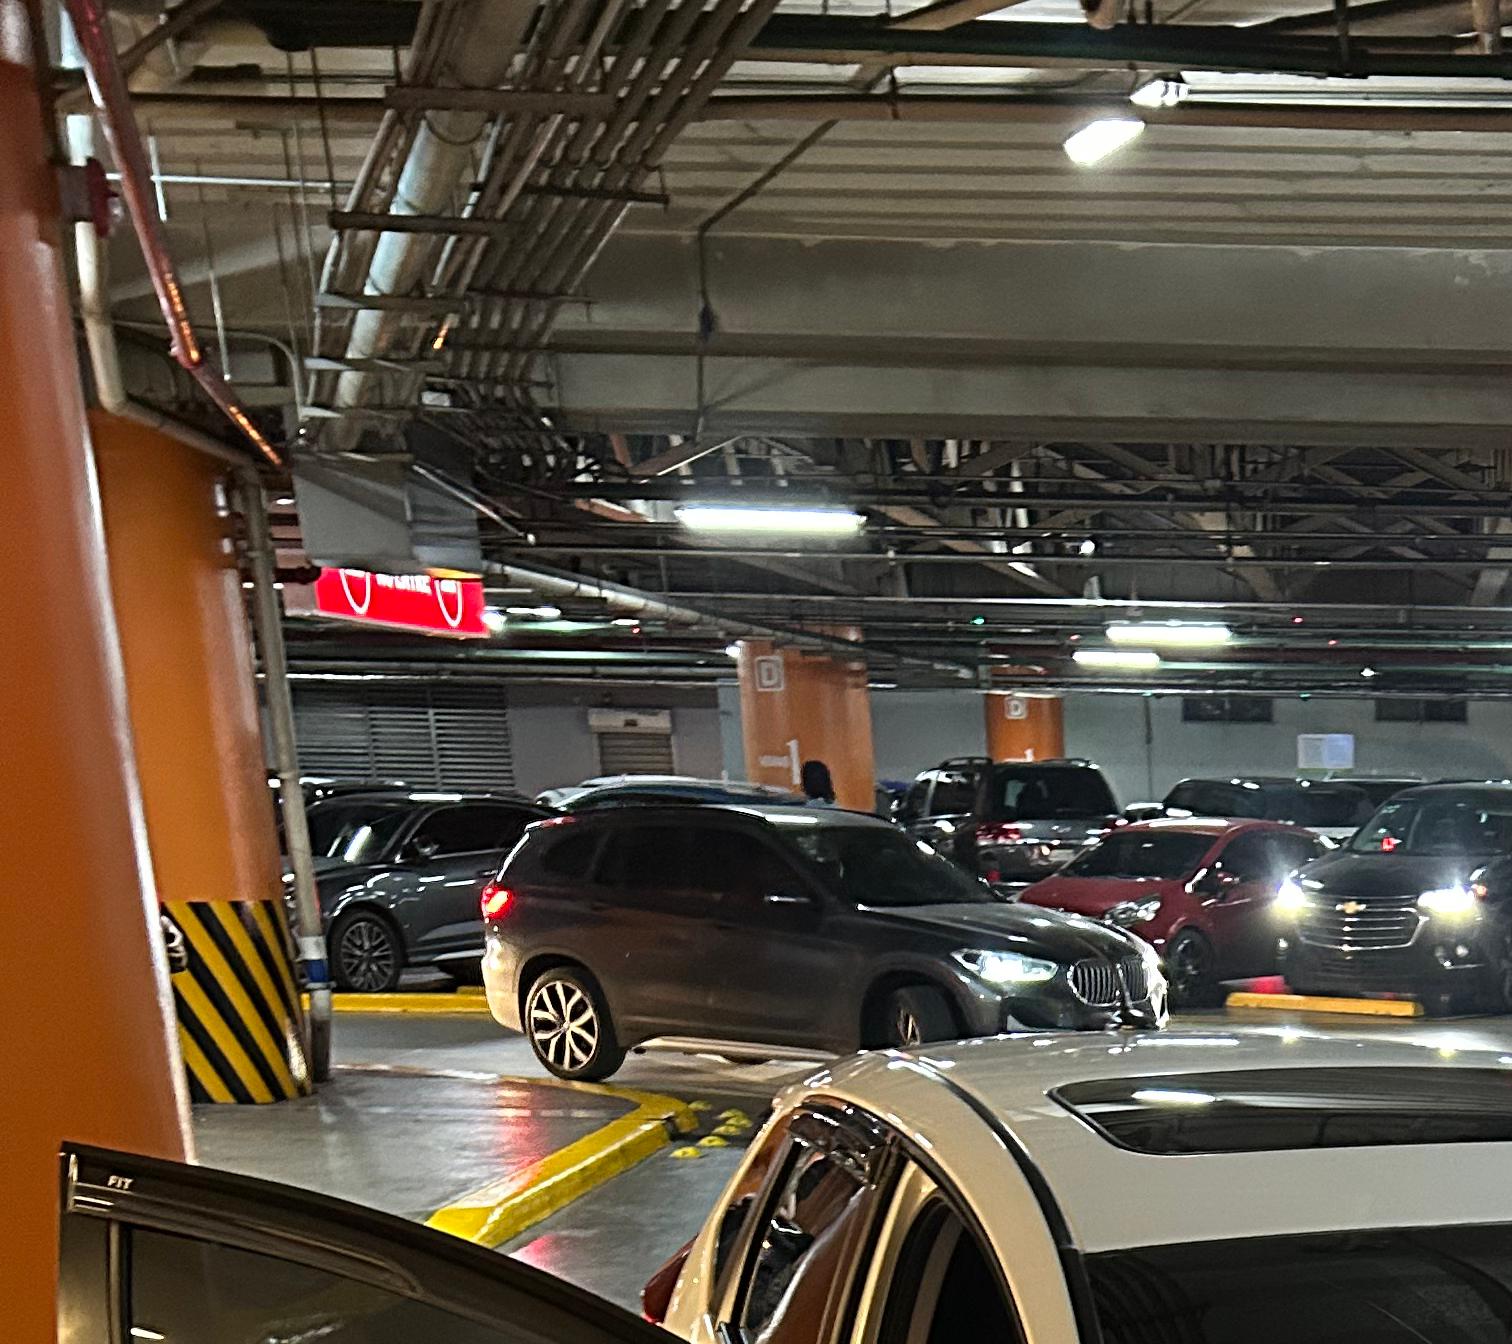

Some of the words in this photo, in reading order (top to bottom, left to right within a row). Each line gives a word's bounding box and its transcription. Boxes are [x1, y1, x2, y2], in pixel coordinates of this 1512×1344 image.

[760, 661, 778, 687] D
[785, 739, 801, 784] 1
[108, 1175, 133, 1189] FIT
